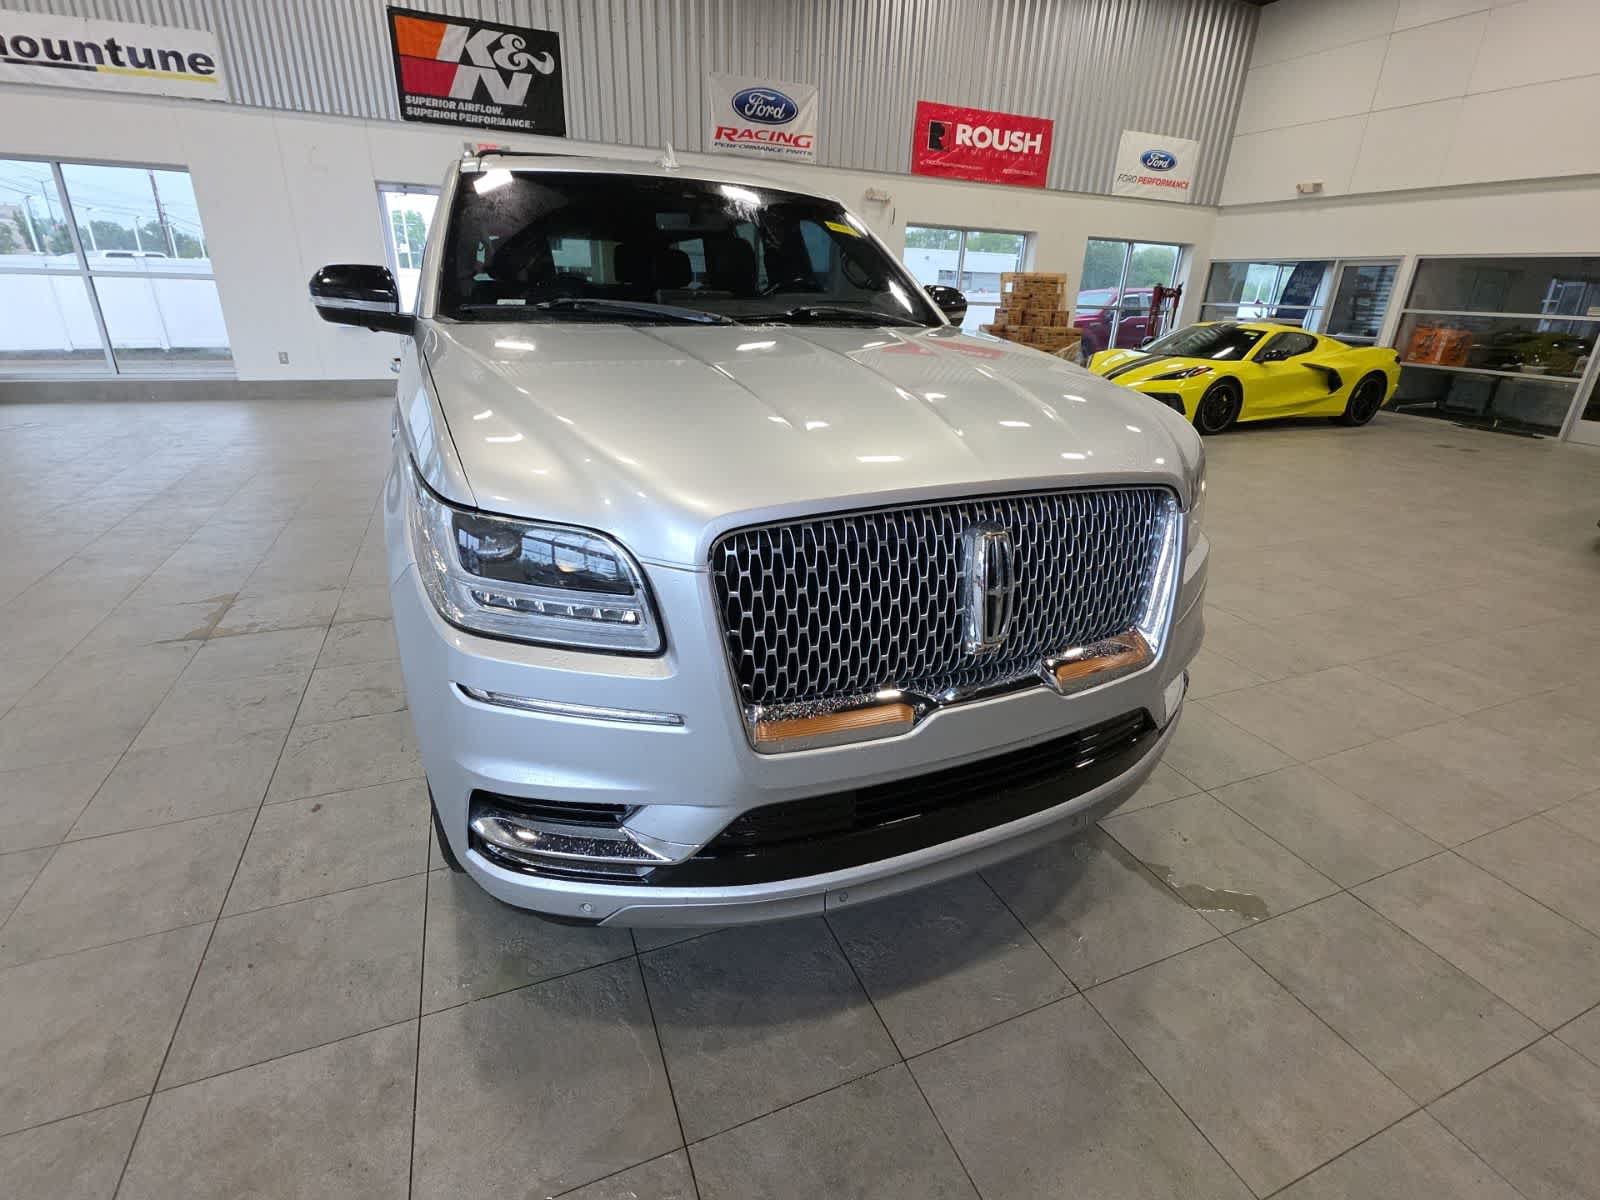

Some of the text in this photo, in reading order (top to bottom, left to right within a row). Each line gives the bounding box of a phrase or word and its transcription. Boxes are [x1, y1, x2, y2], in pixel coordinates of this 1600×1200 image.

[0, 33, 215, 75] ountune
[404, 95, 504, 116] SUPERIOR AIRFLOW.
[406, 106, 458, 121] SUPERIOR
[744, 92, 785, 119] Ford
[714, 125, 814, 149] RACING
[714, 141, 784, 153] PERFORMANCE
[955, 123, 1042, 154] ROUSH
[1117, 173, 1137, 184] FORD
